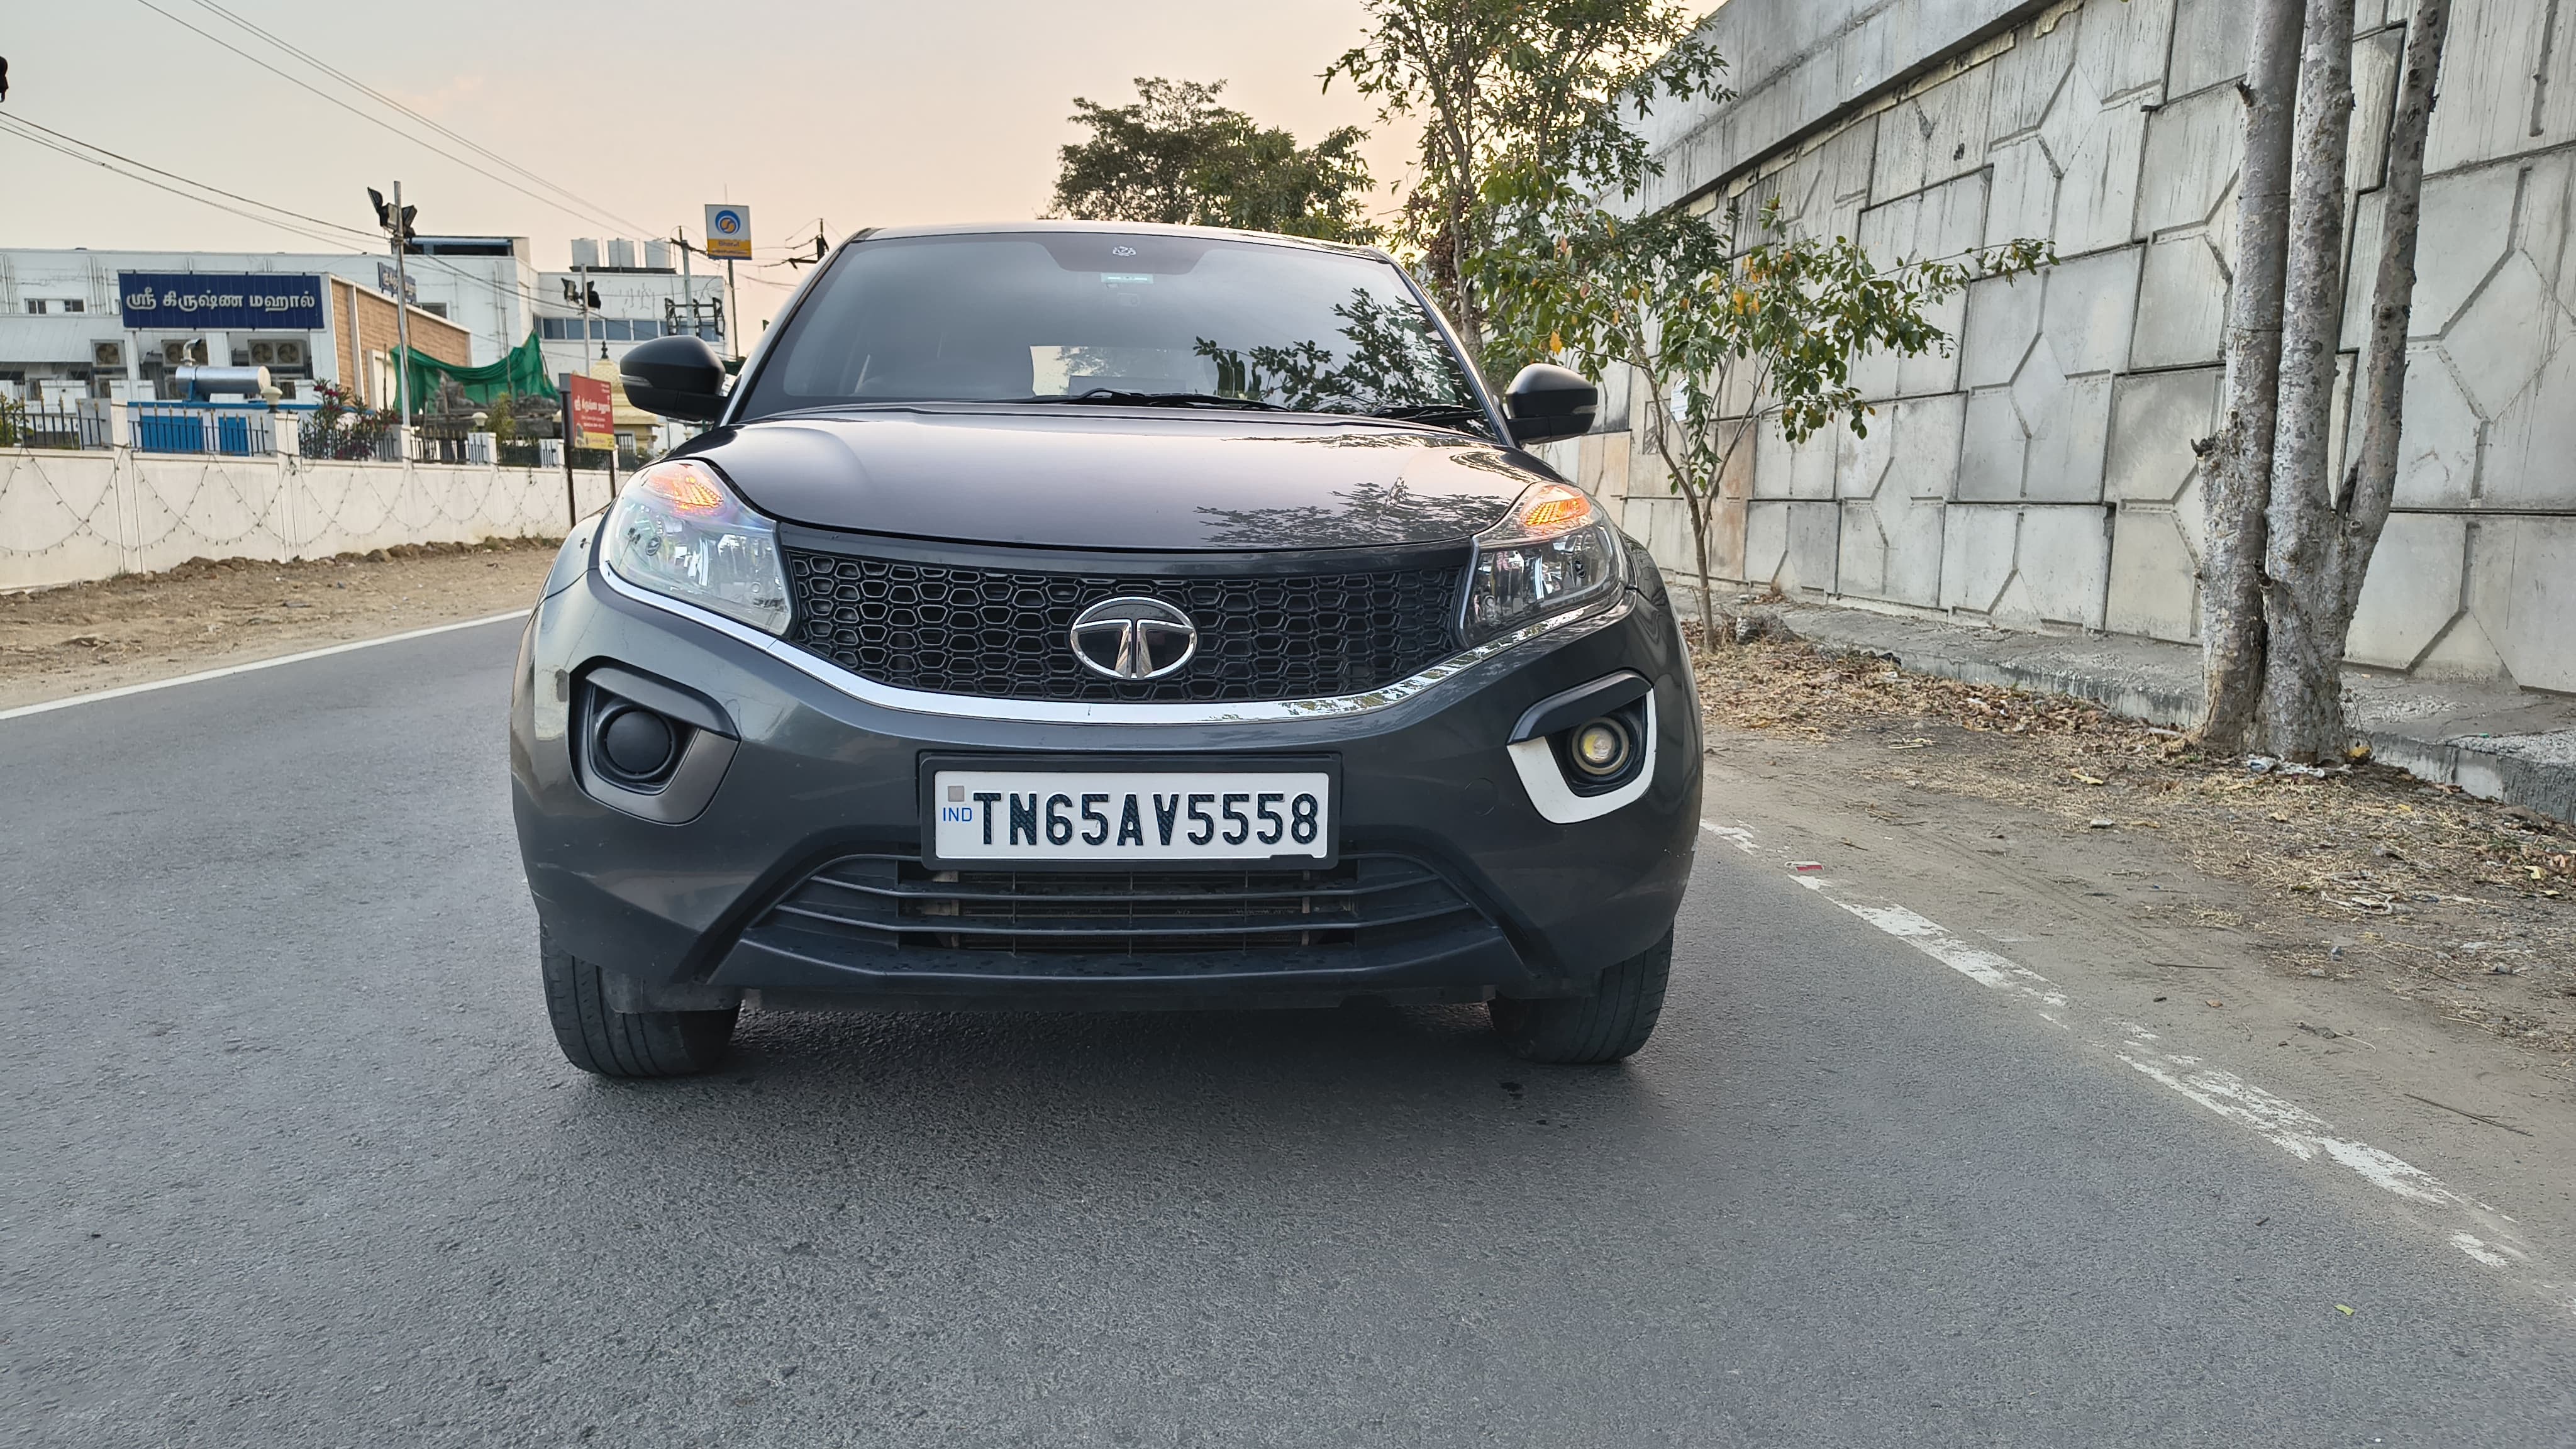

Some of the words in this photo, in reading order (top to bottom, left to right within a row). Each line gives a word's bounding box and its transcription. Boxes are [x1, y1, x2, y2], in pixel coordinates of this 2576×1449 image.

[163, 289, 243, 312] கிருஷ்ண
[250, 290, 316, 313] மஹால்
[943, 808, 972, 823] IND
[973, 792, 1318, 846] TN65AV5558
